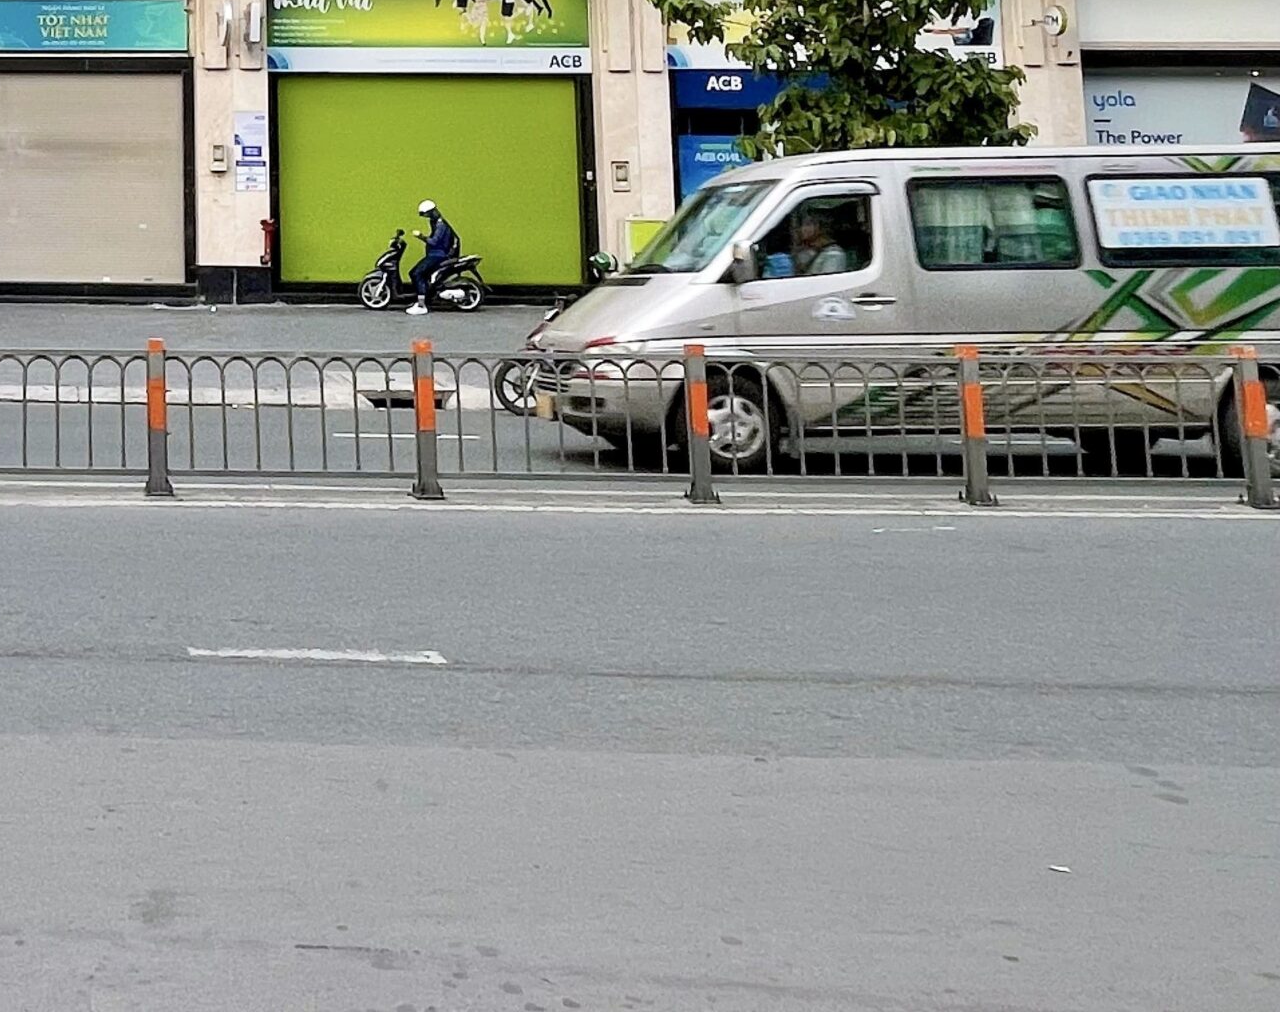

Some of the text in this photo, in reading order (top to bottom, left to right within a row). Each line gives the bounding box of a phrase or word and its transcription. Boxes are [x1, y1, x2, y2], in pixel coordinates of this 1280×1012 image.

[73, 27, 108, 38] NAM
[549, 55, 583, 69] ACB
[706, 75, 743, 91] ACB
[1093, 90, 1136, 111] yola
[1095, 130, 1183, 144] The Power
